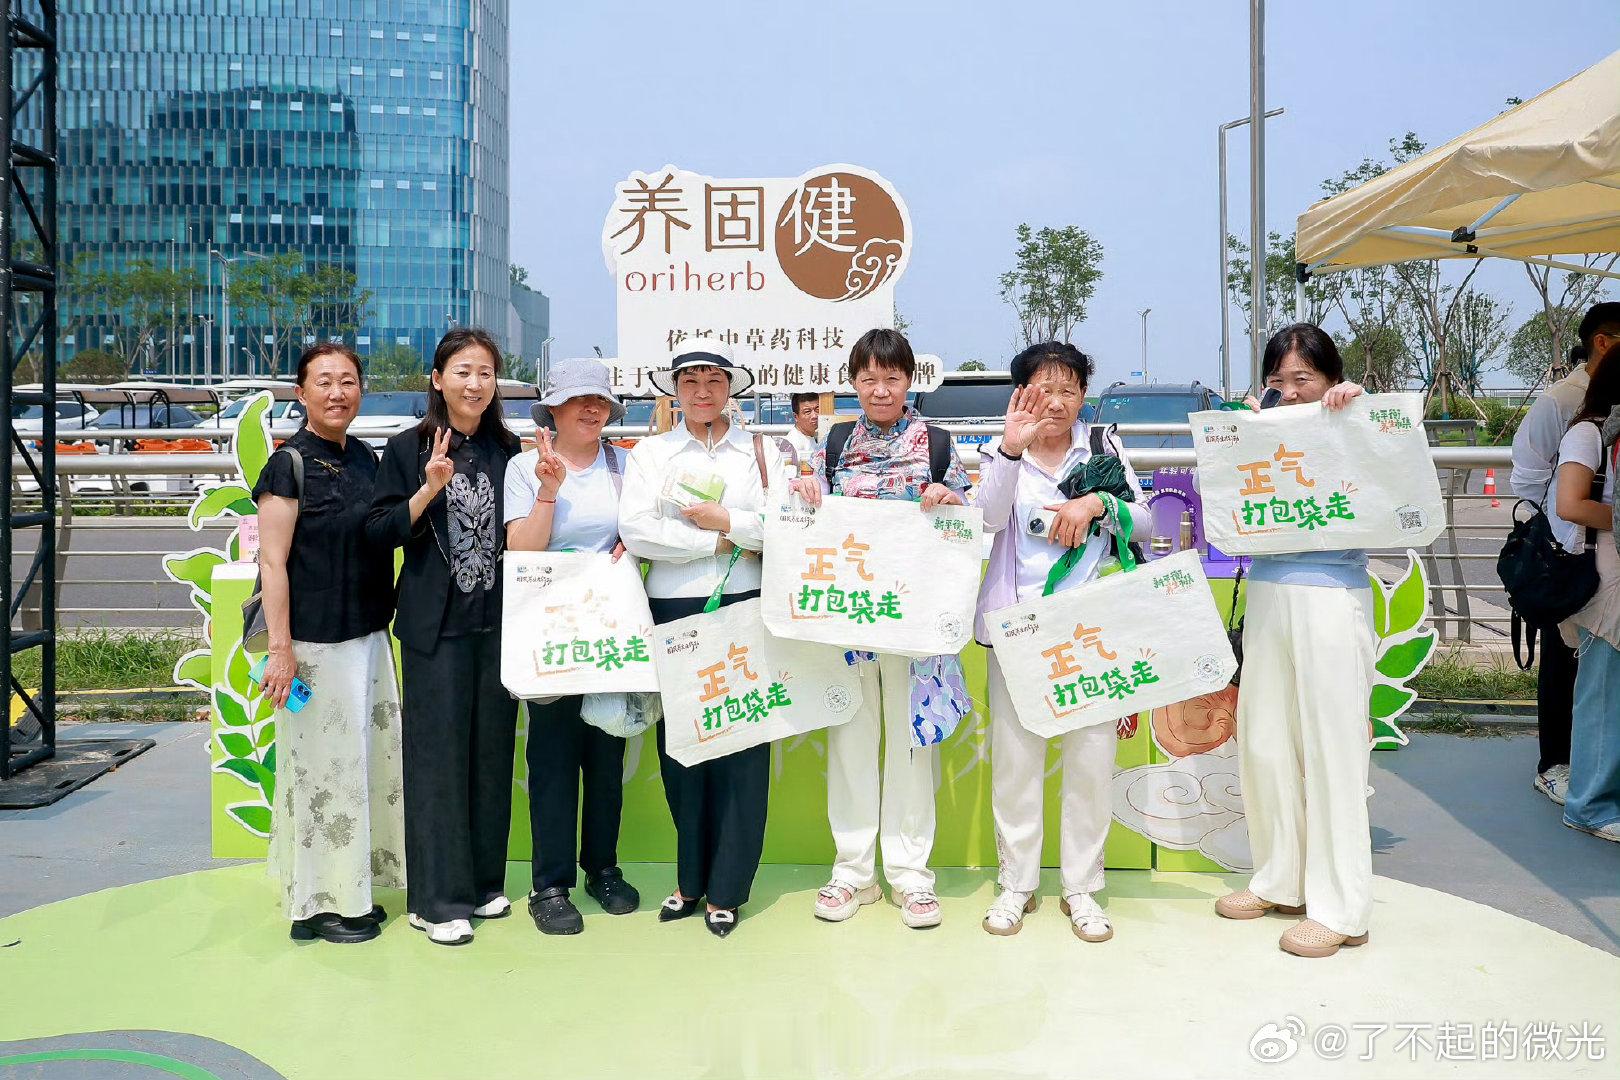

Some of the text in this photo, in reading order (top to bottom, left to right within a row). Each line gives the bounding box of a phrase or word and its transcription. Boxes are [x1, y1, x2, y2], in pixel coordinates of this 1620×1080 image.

[610, 173, 858, 257] 养固健
[625, 260, 765, 292] oriherb
[1236, 443, 1315, 496] 正气
[1241, 491, 1356, 531] 打包袋走
[801, 533, 874, 581] 正气
[797, 584, 903, 624] 打包袋走
[541, 635, 650, 672] 打包袋走
[696, 642, 759, 702] 正气
[1041, 623, 1117, 681] 正气
[702, 682, 792, 731] 打包袋走
[1052, 660, 1160, 707] 打包袋走
